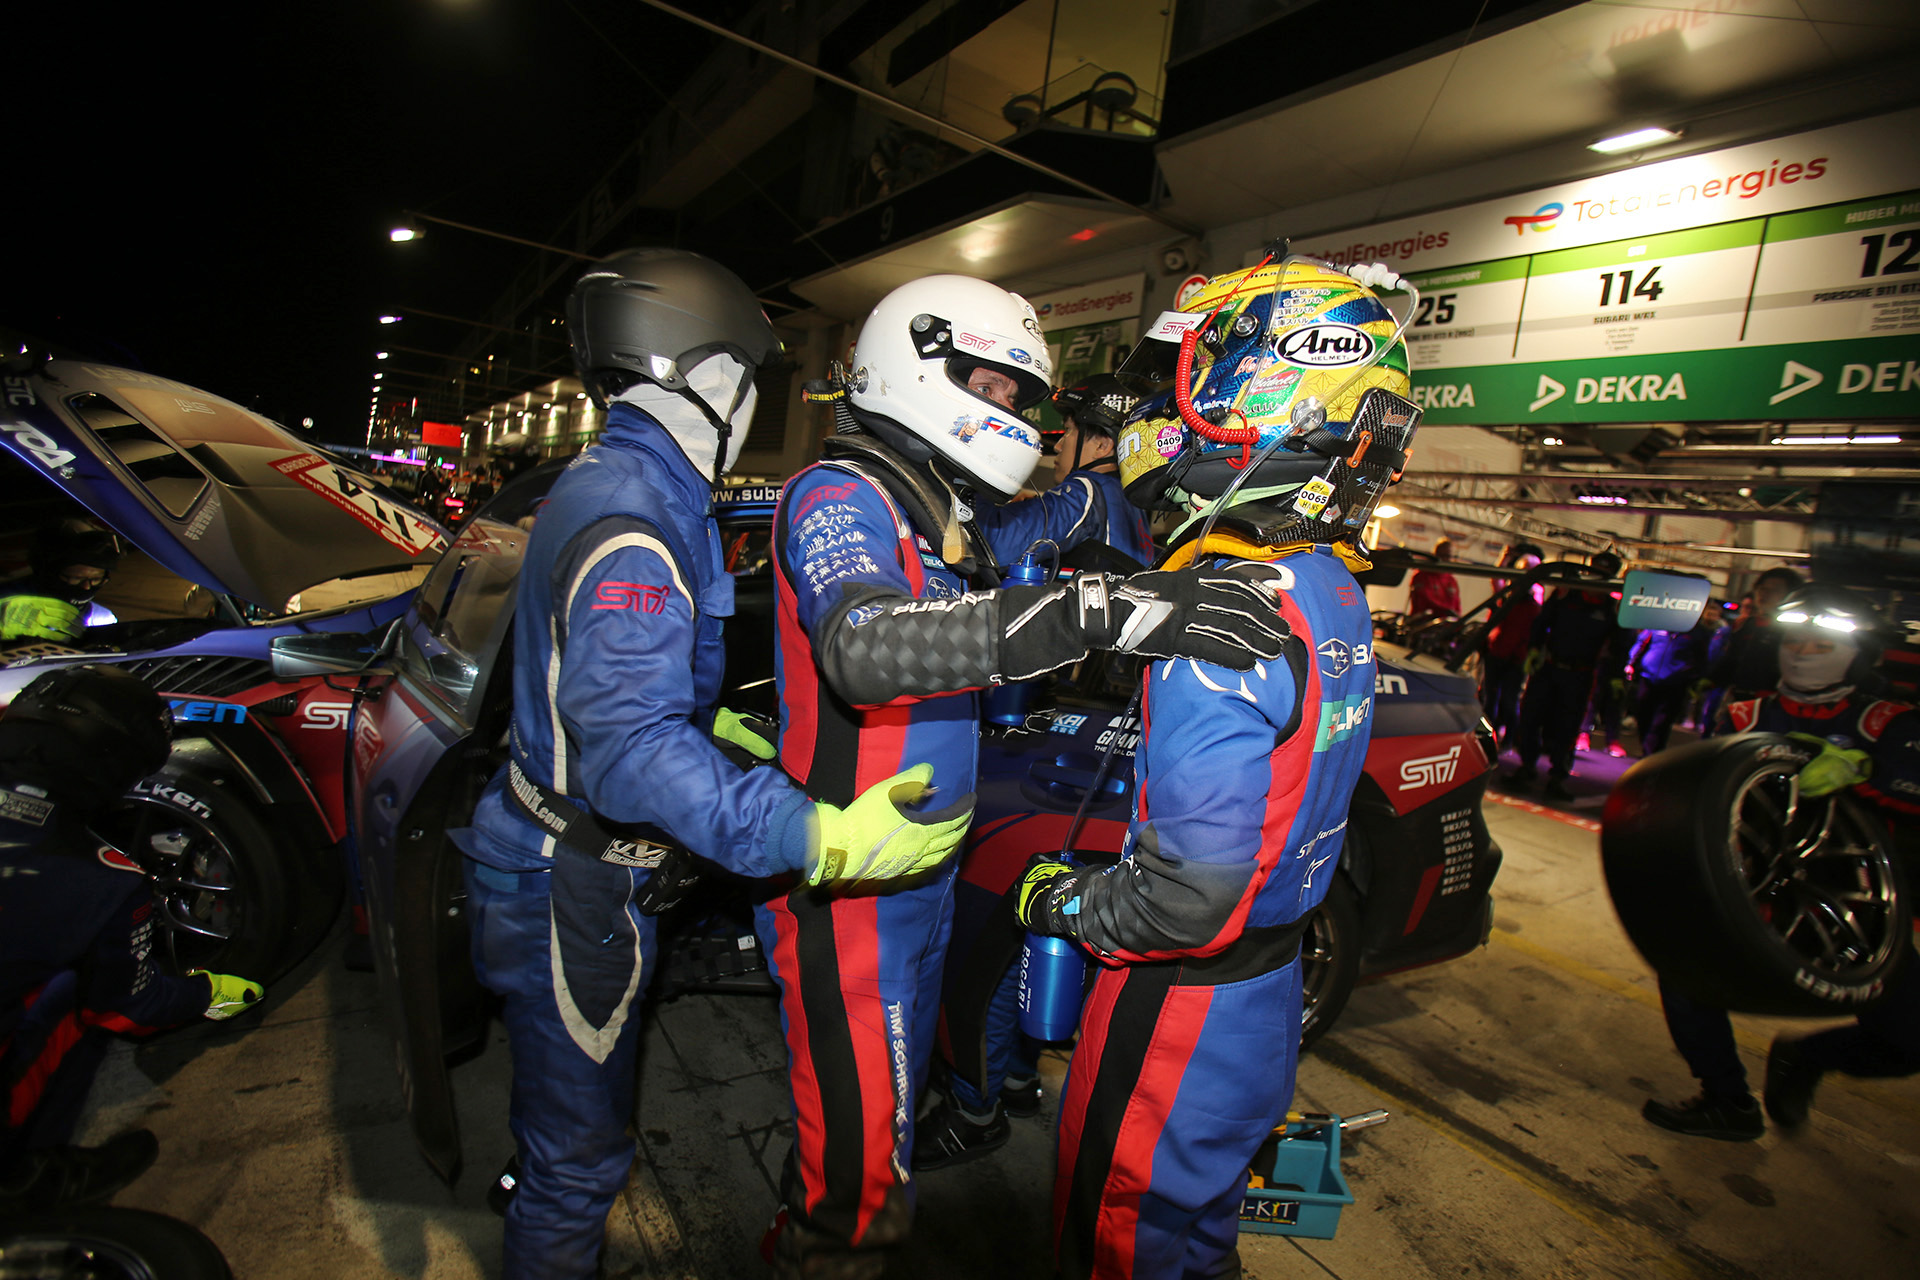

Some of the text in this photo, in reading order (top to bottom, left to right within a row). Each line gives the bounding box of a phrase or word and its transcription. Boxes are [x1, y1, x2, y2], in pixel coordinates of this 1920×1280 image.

[1600, 265, 1664, 307] 114
[1414, 293, 1458, 327] 25
[1593, 314, 1631, 325] SUBARU
[1294, 327, 1365, 355] Arai
[1574, 372, 1688, 405] DEKRA
[1157, 435, 1181, 448] 0409
[1300, 490, 1328, 505] 0065
[887, 1000, 906, 1037] TIM
[892, 1038, 911, 1127] SCHRICK
